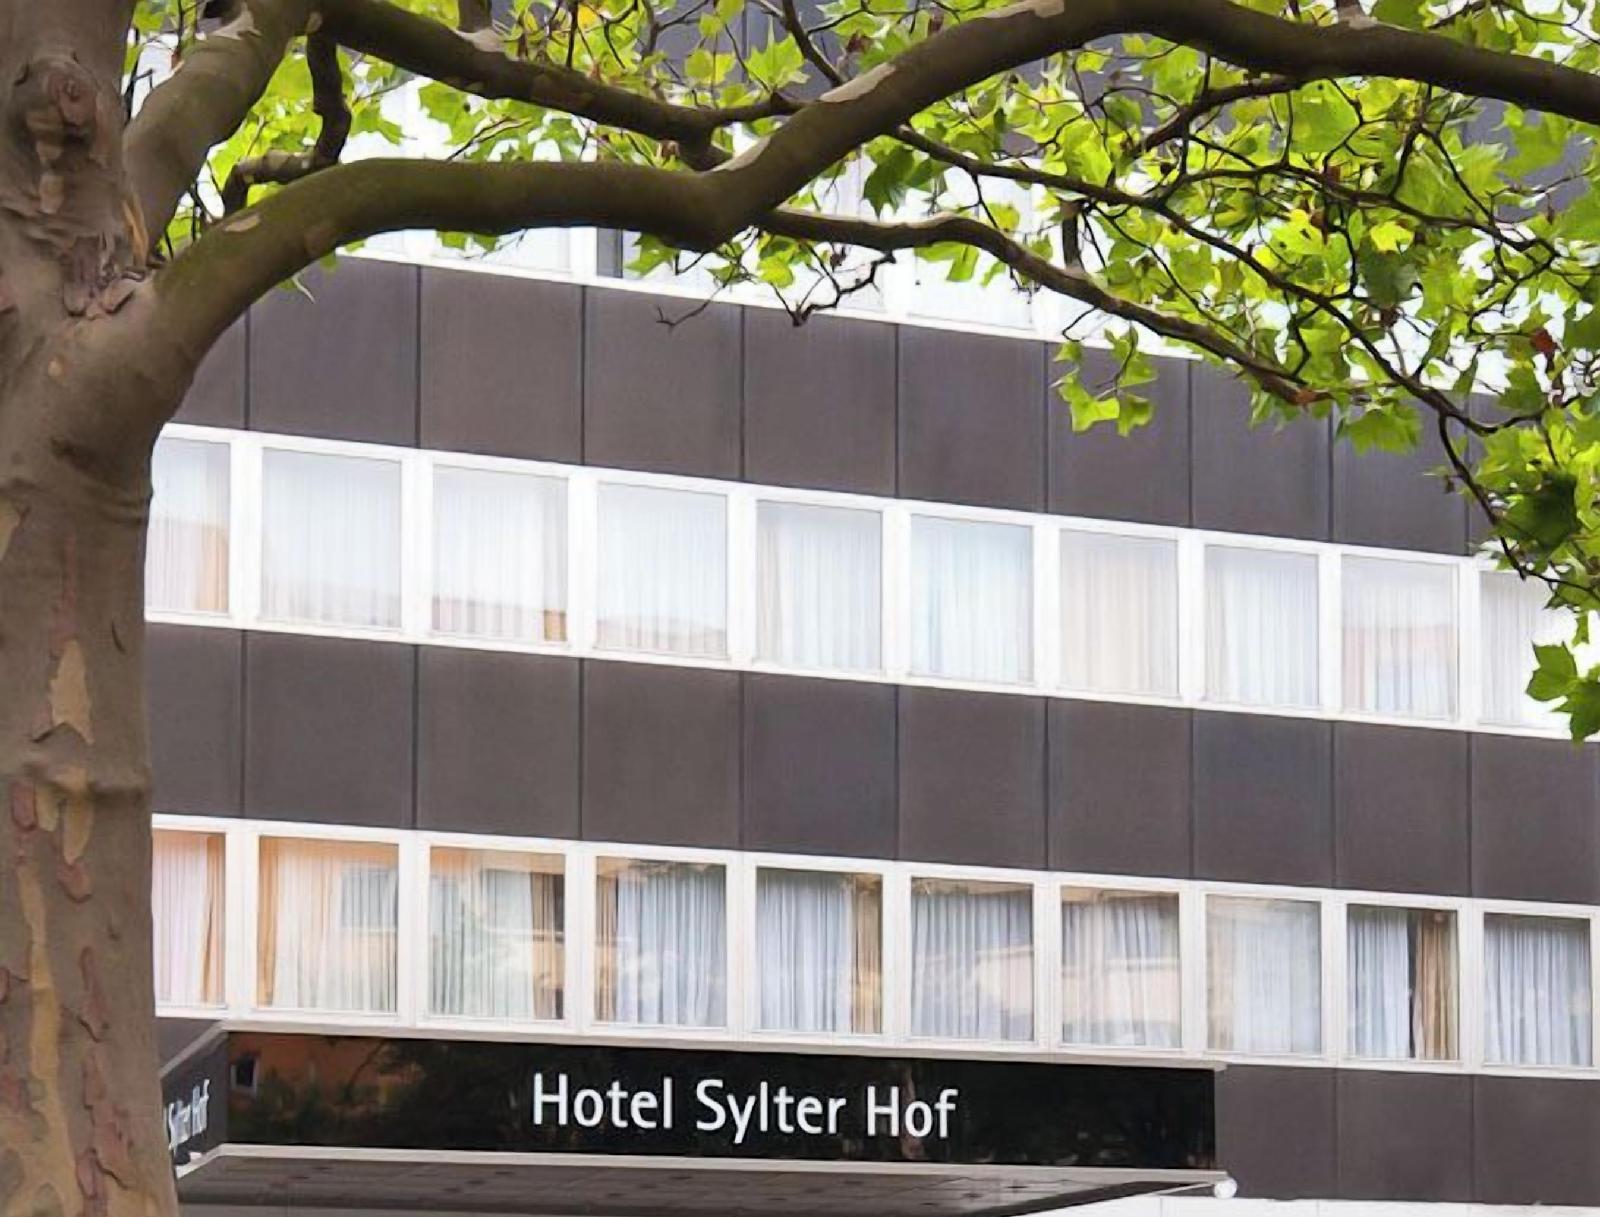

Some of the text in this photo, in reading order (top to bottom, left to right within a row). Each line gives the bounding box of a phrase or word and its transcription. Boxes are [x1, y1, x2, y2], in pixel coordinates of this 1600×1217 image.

[533, 1072, 958, 1144] Hotel Sylter Hof
